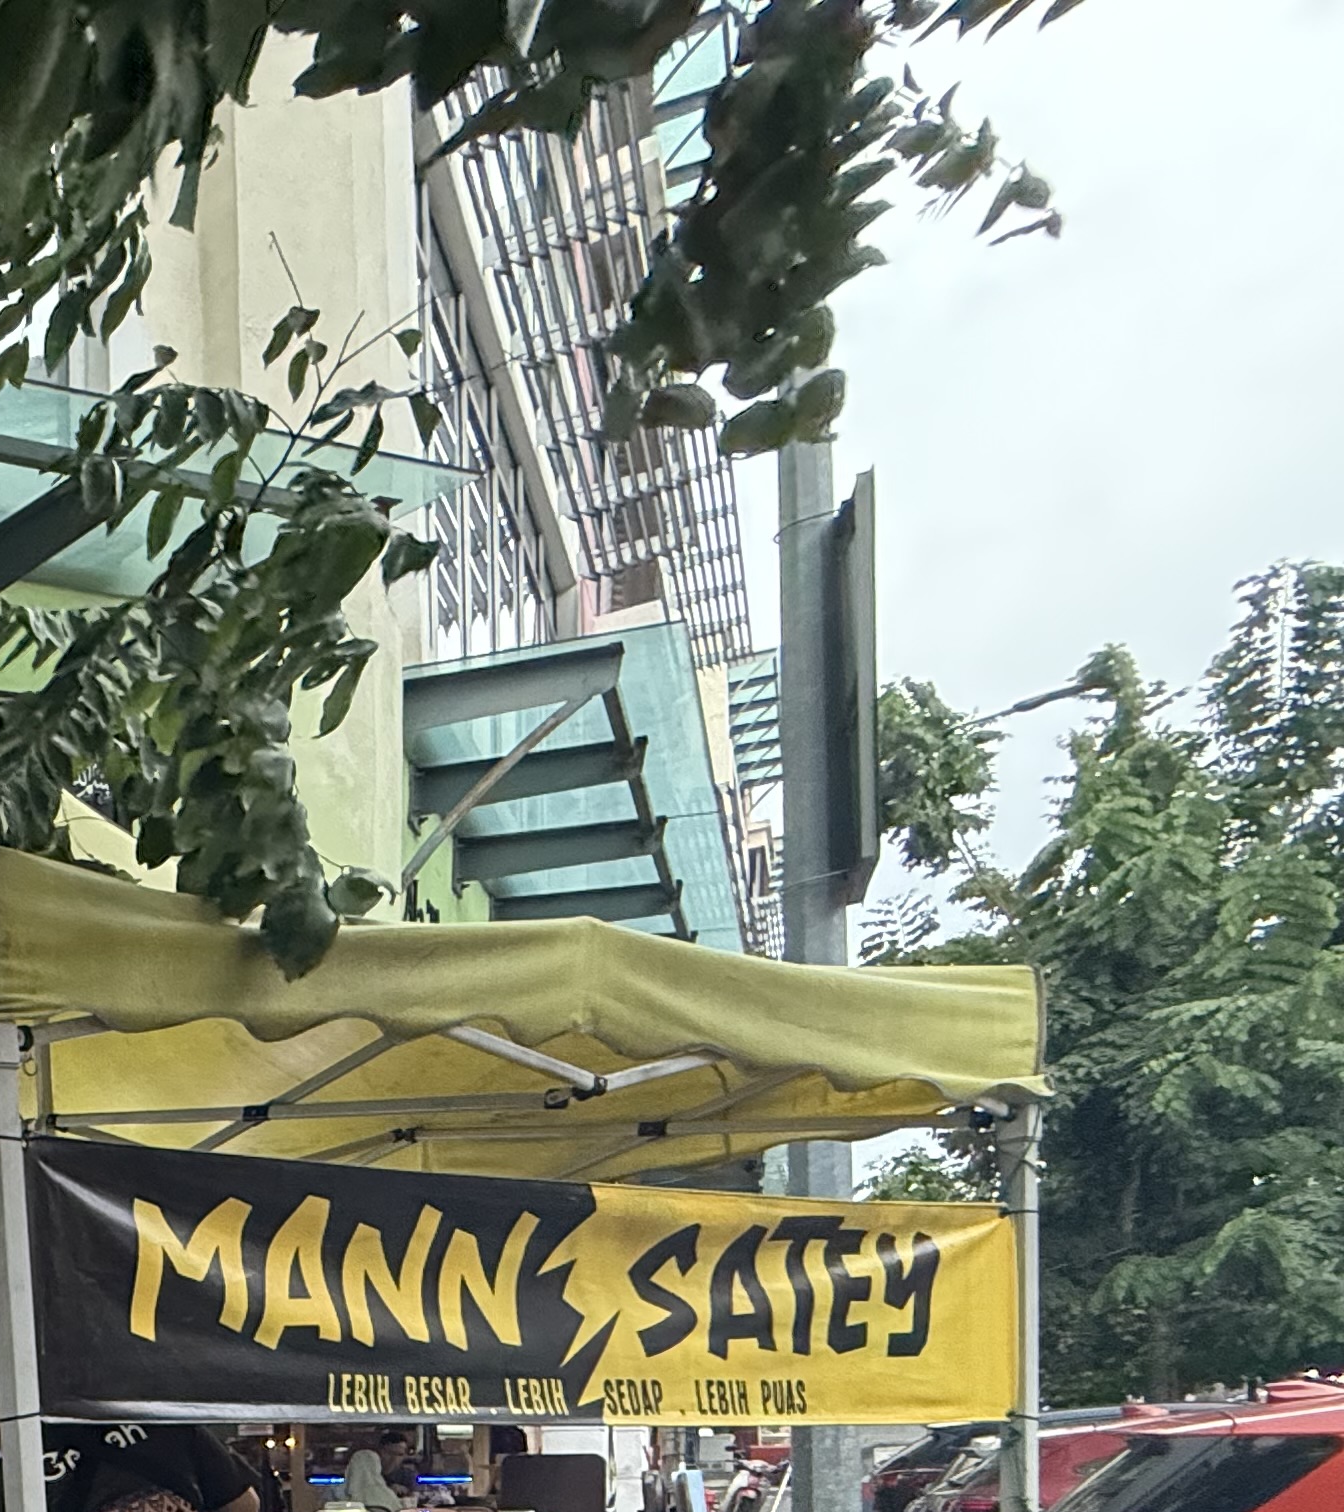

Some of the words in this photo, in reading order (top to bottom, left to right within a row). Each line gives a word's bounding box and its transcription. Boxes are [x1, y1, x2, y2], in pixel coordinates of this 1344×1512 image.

[627, 1215, 941, 1360] SATEY
[328, 1373, 394, 1415] LEBIH
[404, 1375, 478, 1415] BESAR
[504, 1377, 570, 1416] LEBIH
[603, 1378, 663, 1416] SEDAP
[694, 1378, 751, 1416] LEBIH
[759, 1378, 809, 1416] PUAS
